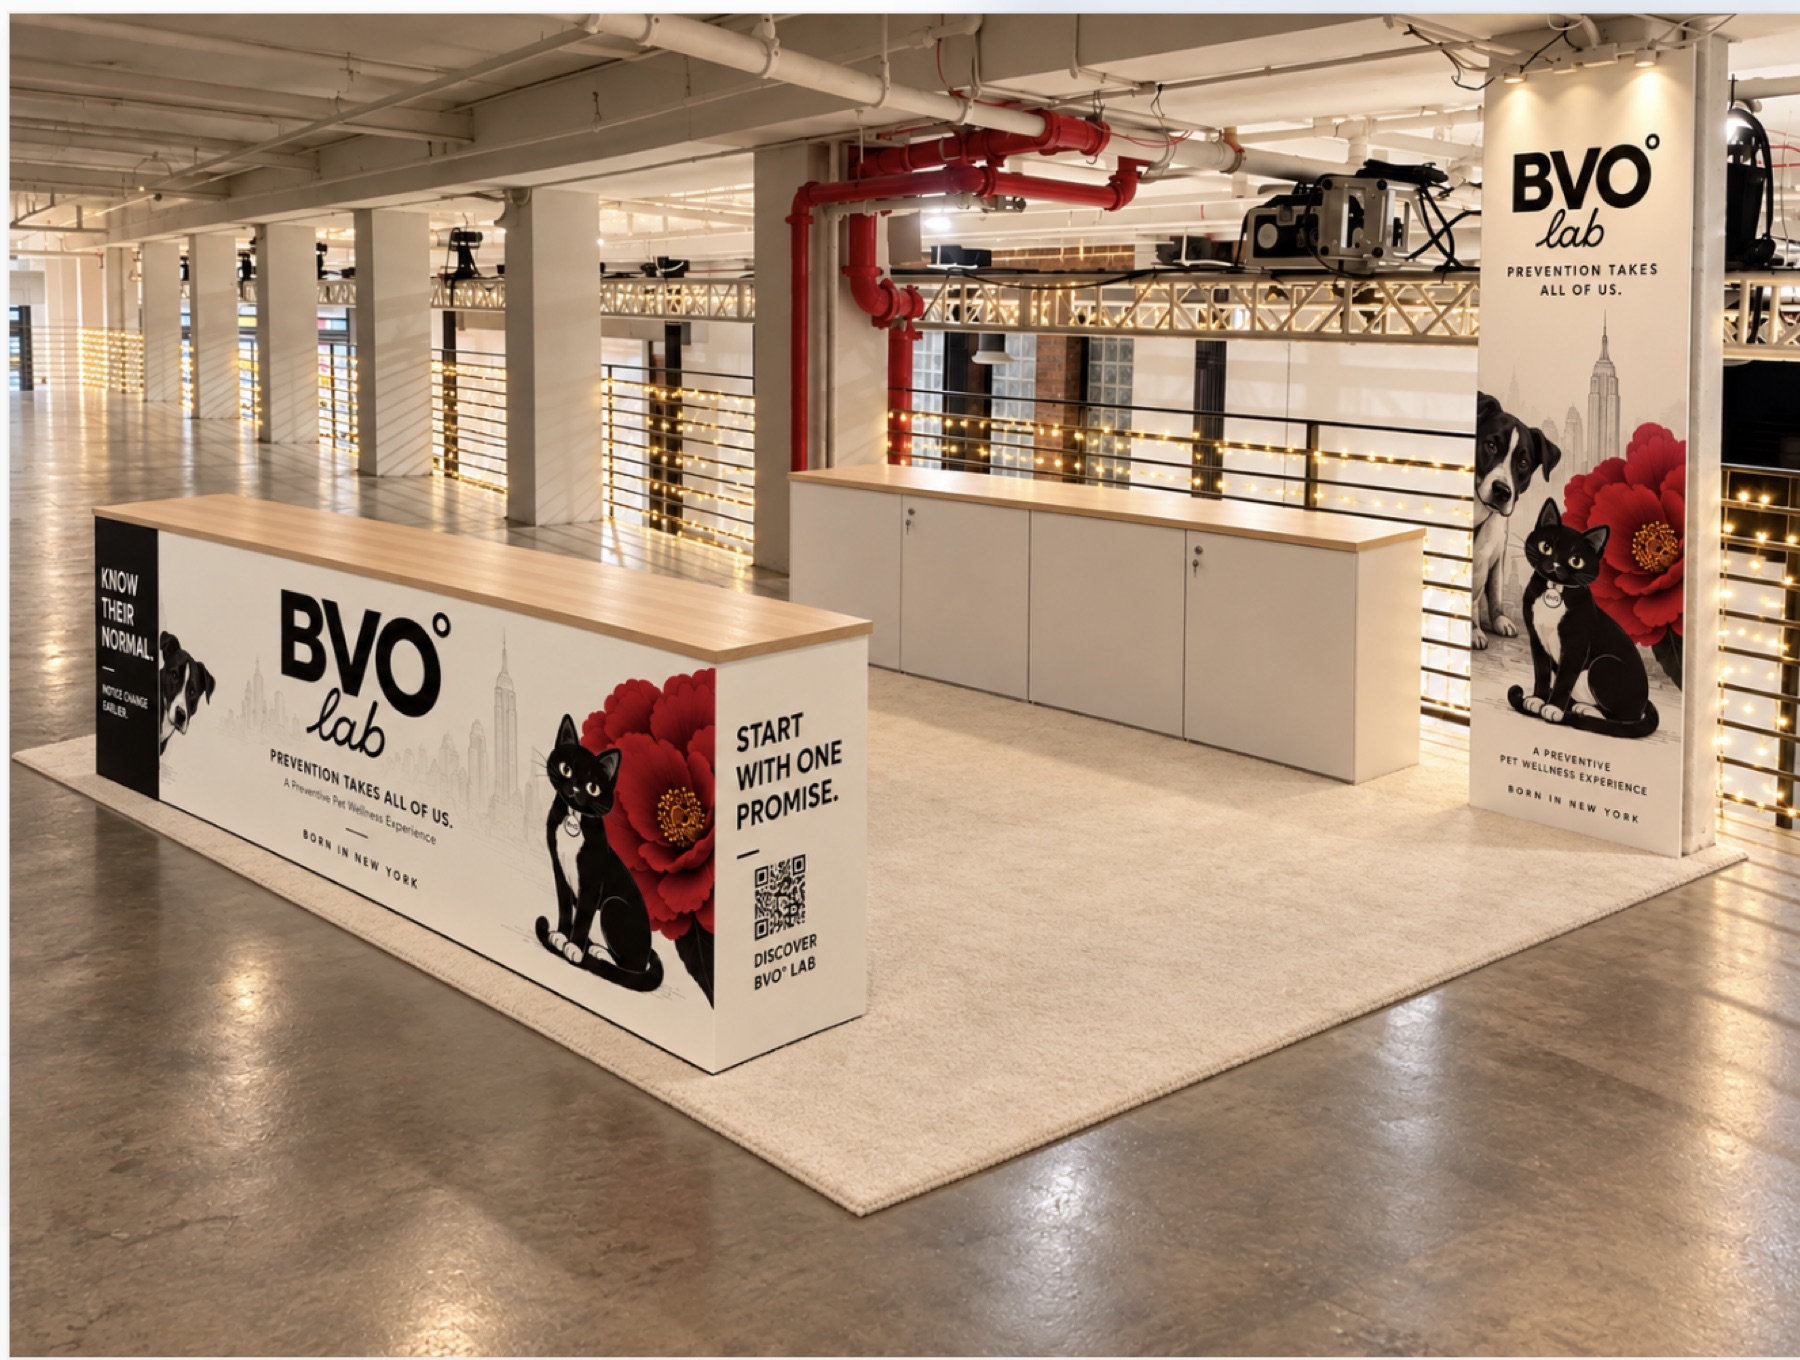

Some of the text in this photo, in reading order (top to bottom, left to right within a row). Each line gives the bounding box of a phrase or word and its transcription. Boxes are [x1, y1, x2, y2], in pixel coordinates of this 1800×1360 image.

[1535, 207, 1604, 248] lab
[1507, 262, 1658, 278] PREVENTION TAKES
[1540, 284, 1622, 296] ALL OF US.
[101, 567, 139, 596] KNOW
[101, 597, 134, 626] THEIR
[101, 625, 153, 661] NORMAL.
[306, 687, 385, 758] lab
[736, 712, 804, 752] START
[736, 740, 843, 791] WITH ONE
[1500, 754, 1648, 796] PET WELLNESS EXPERIENCE
[1532, 747, 1611, 772] A PREVENTIVE
[270, 748, 453, 829] PREVENTION TAKES ALL OF US.
[736, 779, 839, 831] PROMISE.
[1507, 784, 1639, 824] BORN IN NEW YORK
[283, 778, 437, 845] A Preventive Pet Wellness Experience
[303, 829, 418, 889] BORN IN NEW YORK
[754, 933, 817, 968] DISCOVER
[790, 956, 816, 978] LAB
